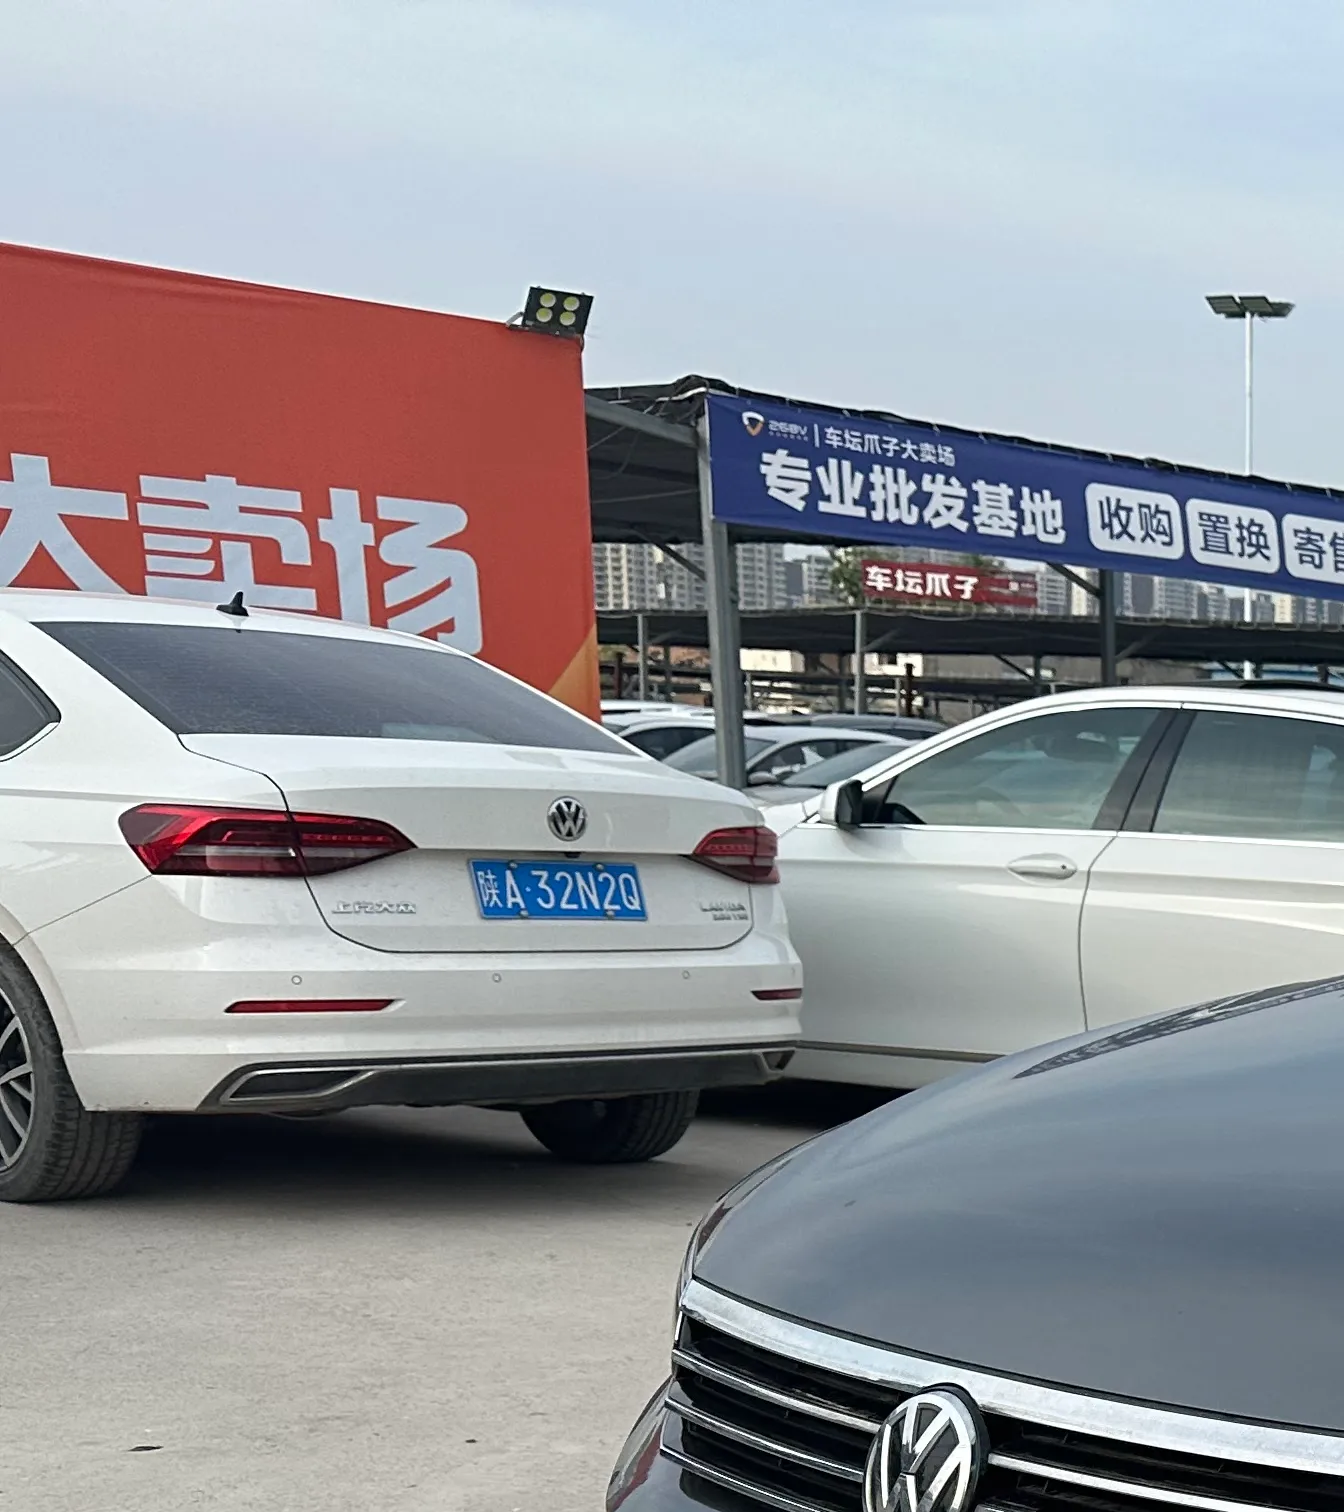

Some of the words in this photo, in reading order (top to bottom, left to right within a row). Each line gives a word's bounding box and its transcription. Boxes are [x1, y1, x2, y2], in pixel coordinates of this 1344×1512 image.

[823, 426, 956, 467] 车坛爪子大卖场
[760, 448, 1066, 544] 专业批发基地
[1099, 495, 1174, 547] 收购
[1198, 511, 1272, 562] 置换
[0, 453, 483, 655] 大卖场
[865, 565, 980, 600] 车坛爪子
